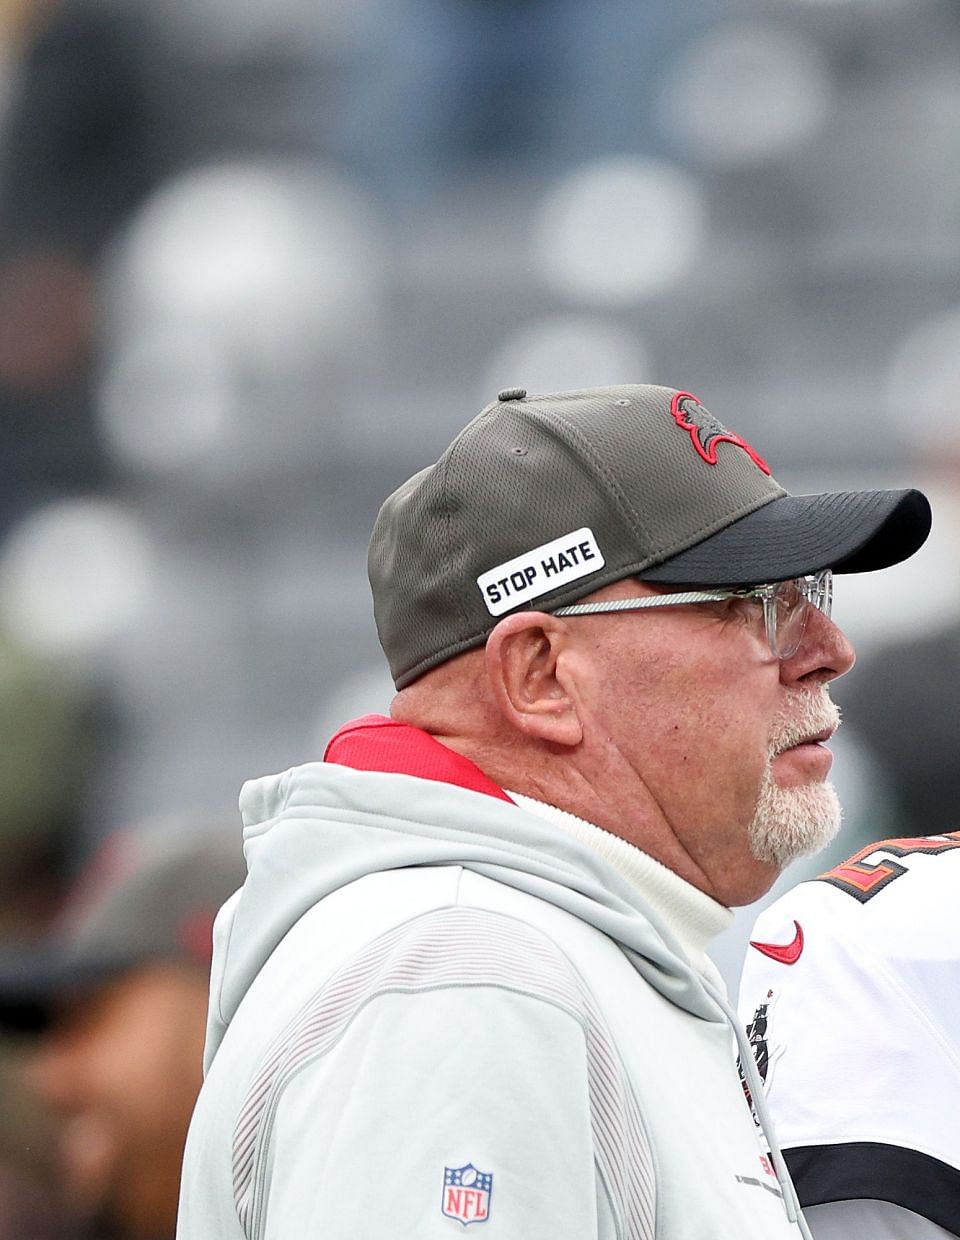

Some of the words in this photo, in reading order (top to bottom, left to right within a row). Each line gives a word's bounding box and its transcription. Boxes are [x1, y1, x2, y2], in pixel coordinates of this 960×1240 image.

[486, 566, 537, 604] STOP
[541, 541, 595, 578] HATE
[446, 1188, 487, 1219] NFL
